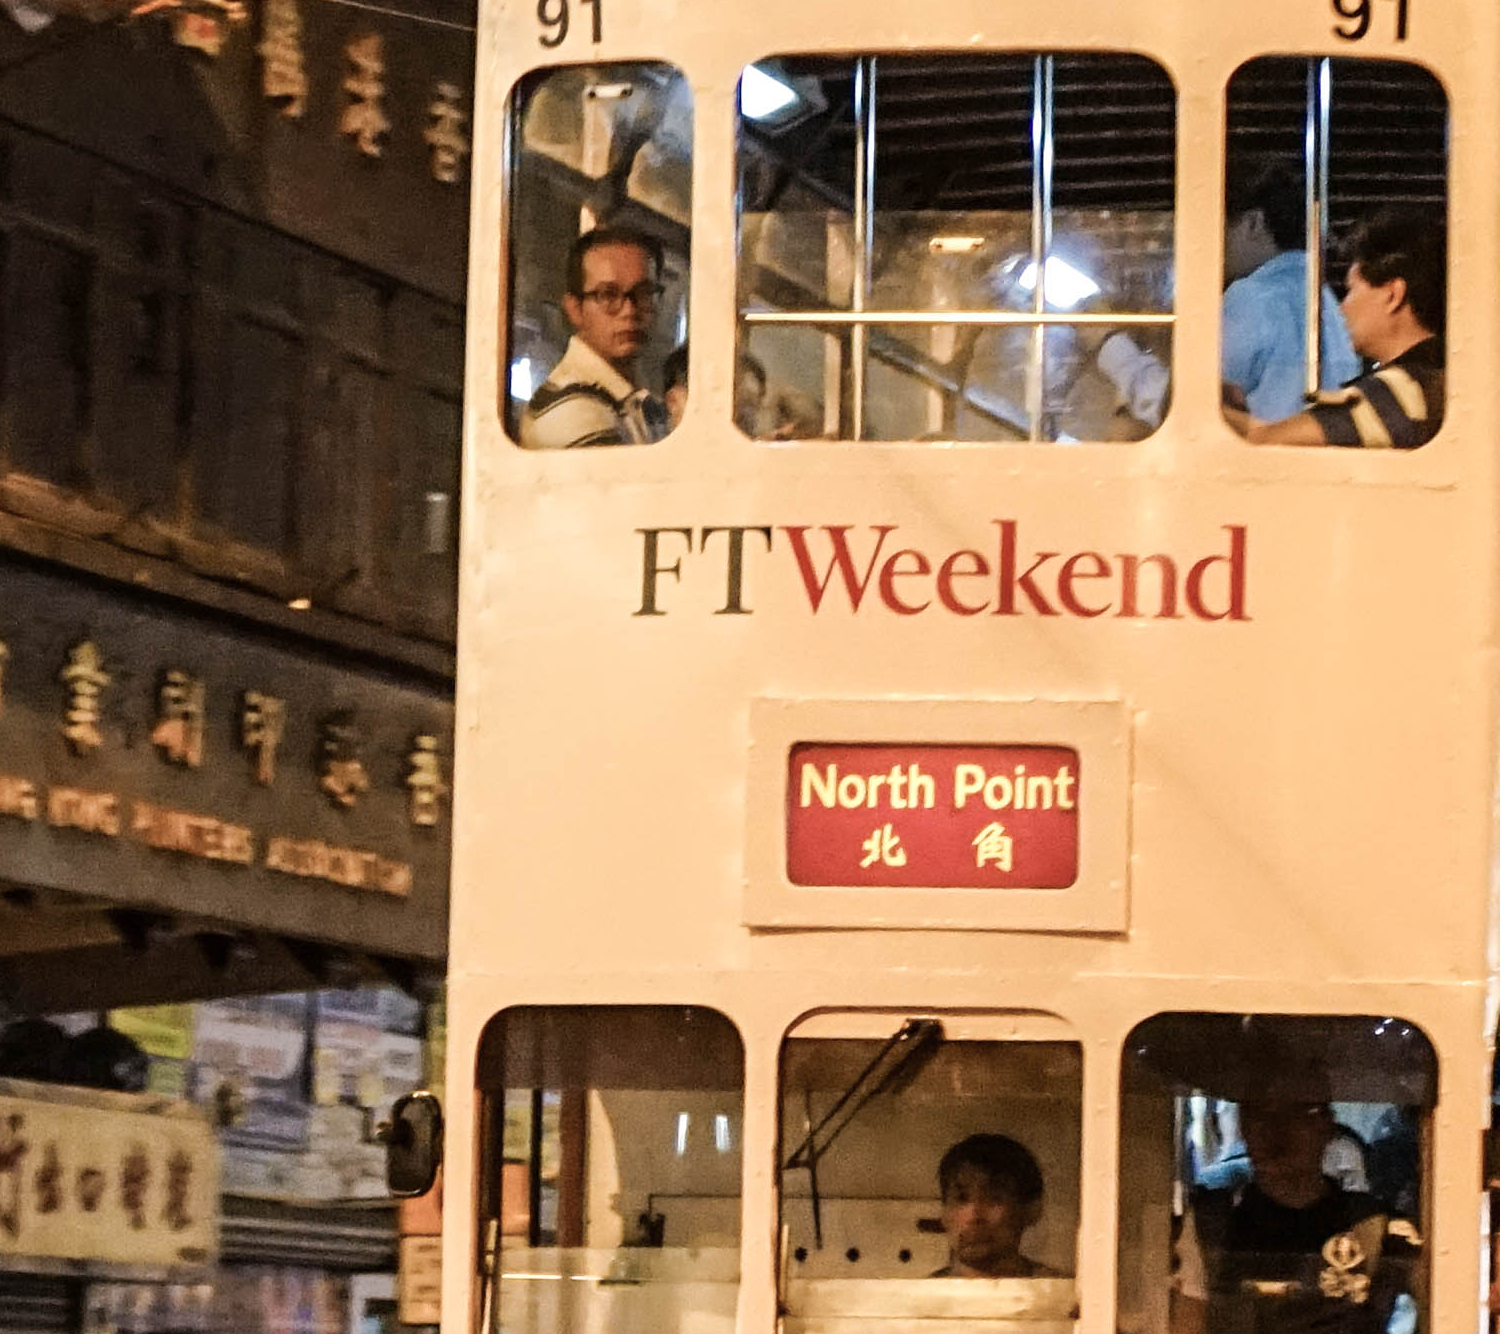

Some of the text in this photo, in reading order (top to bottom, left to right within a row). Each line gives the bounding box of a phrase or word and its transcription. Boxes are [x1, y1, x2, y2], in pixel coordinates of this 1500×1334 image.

[800, 763, 1075, 810] North Point
[859, 821, 1014, 873] 北角
